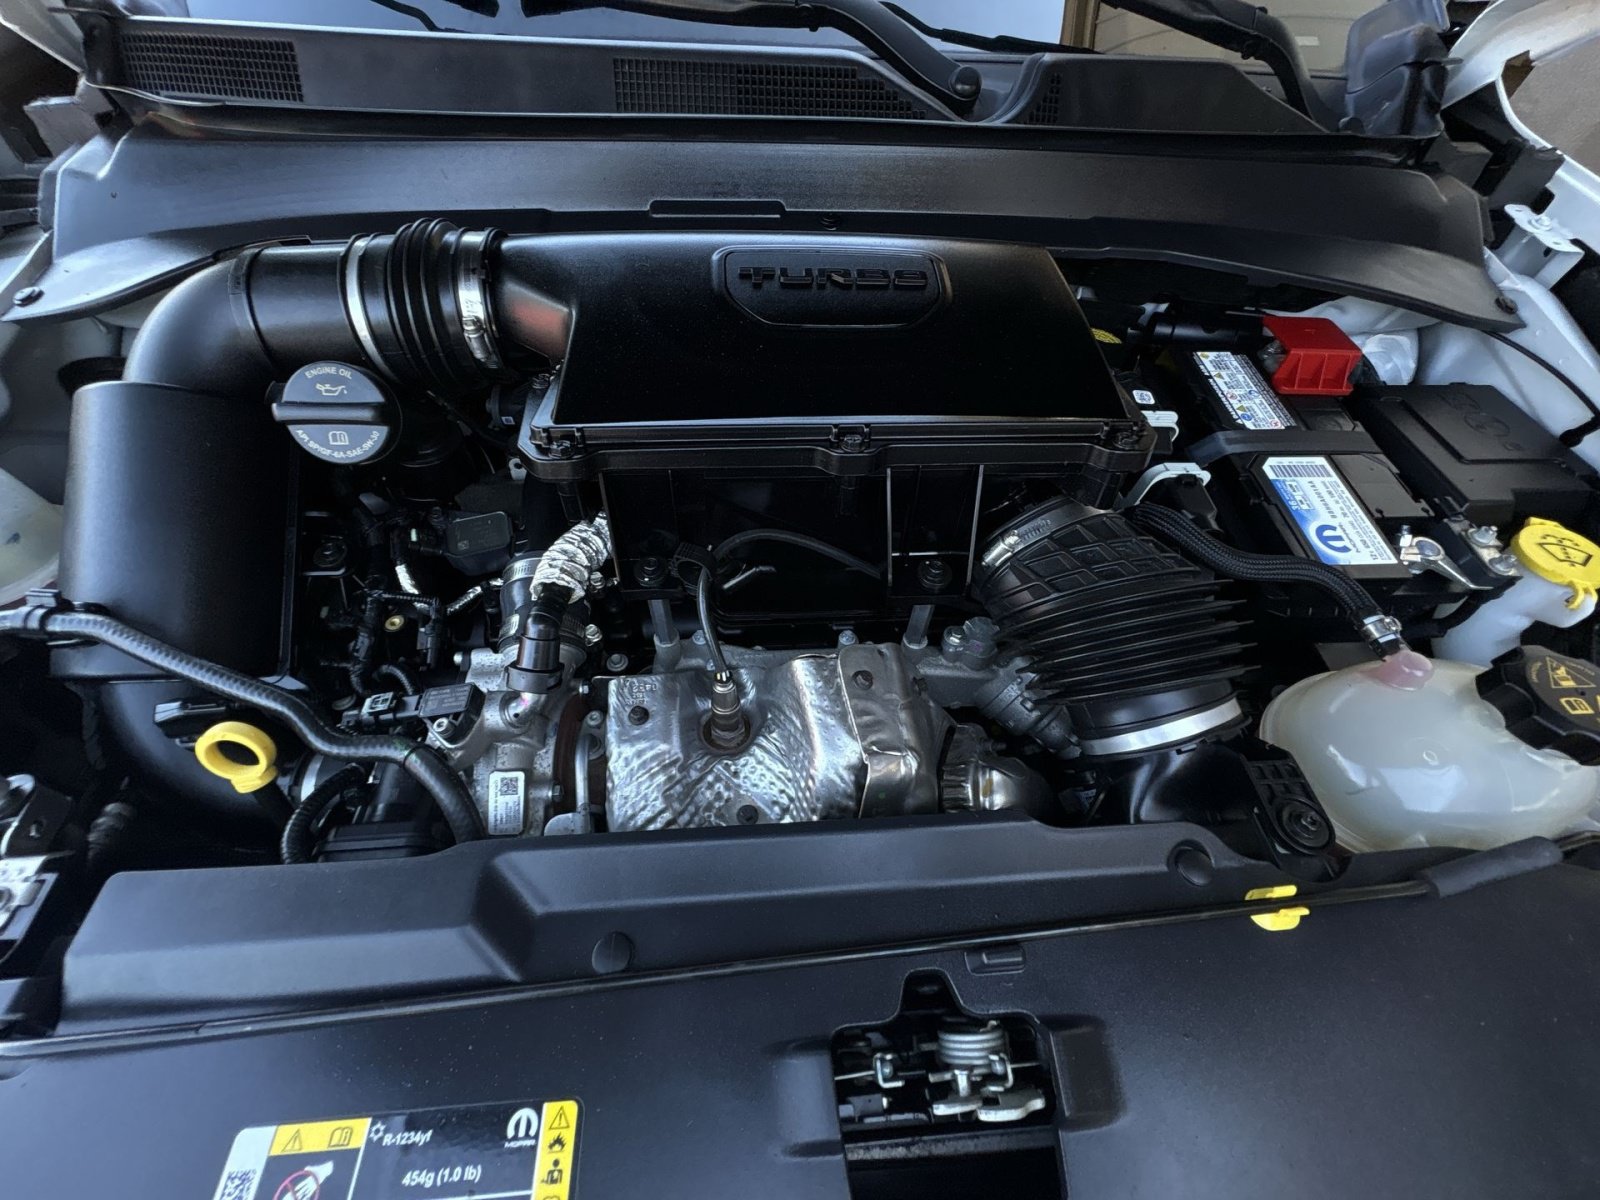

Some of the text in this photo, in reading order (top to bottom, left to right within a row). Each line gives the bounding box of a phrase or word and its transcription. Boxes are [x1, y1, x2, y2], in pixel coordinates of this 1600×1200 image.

[304, 366, 352, 380] ENGINE OIL
[296, 429, 309, 442] API
[382, 1129, 433, 1146] R-1234yf
[401, 1164, 482, 1188] 454g (1.0 lb)
